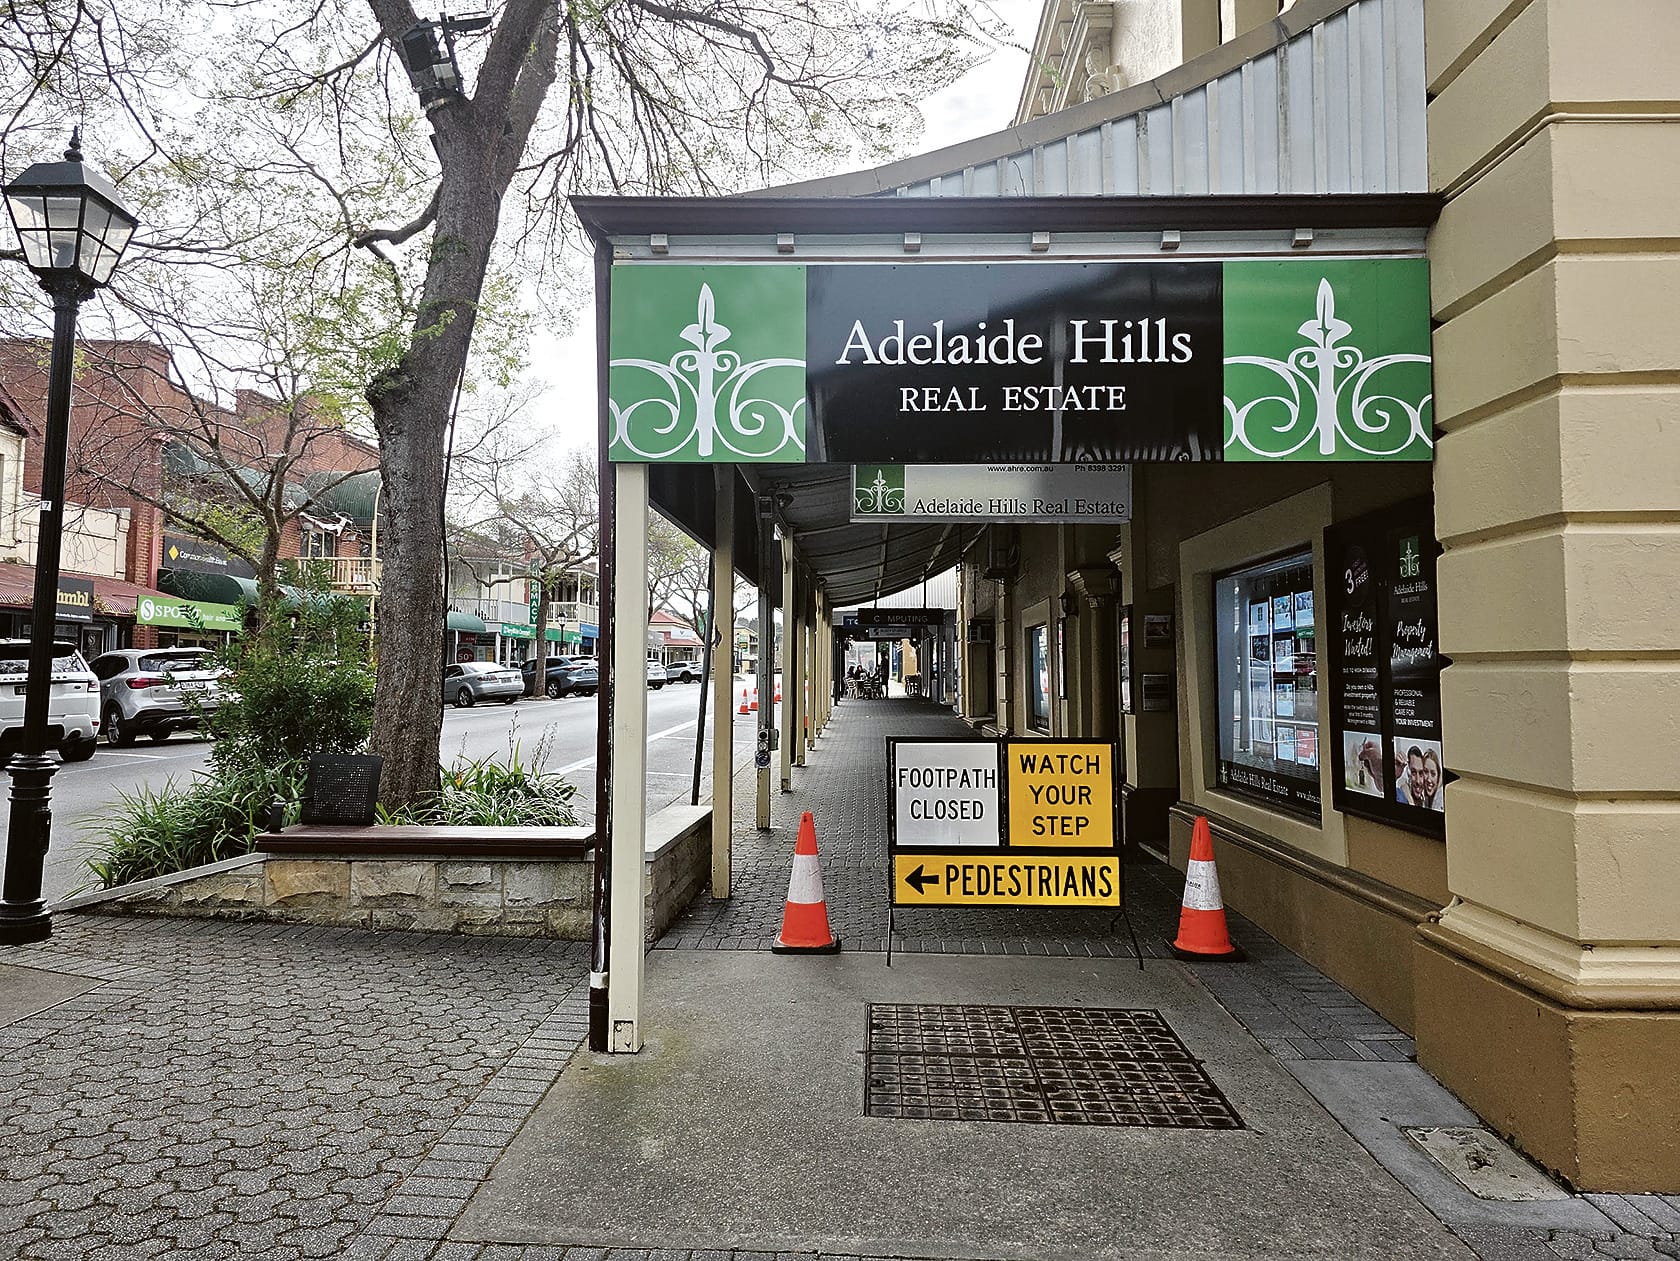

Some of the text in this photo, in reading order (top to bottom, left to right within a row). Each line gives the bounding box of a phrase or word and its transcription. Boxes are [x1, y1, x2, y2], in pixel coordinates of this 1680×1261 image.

[836, 317, 1194, 365] Adelaide Hills
[900, 385, 1127, 412] REAL ESTATE
[987, 464, 1054, 473] www.ahre.com.au
[1074, 464, 1086, 473] Ph
[1108, 464, 1126, 473] 3291
[912, 498, 1126, 515] Adelaide Hills Real Estate
[1345, 568, 1355, 594] 3
[155, 604, 202, 620] SPOT
[1396, 618, 1427, 642] Property
[1019, 753, 1101, 775] WATCH
[898, 767, 997, 789] FOOTPATH
[1028, 784, 1093, 806] YOUR
[909, 799, 985, 821] CLOSED
[1031, 815, 1090, 836] STEP
[945, 863, 1114, 898] PEDESTRIANS
